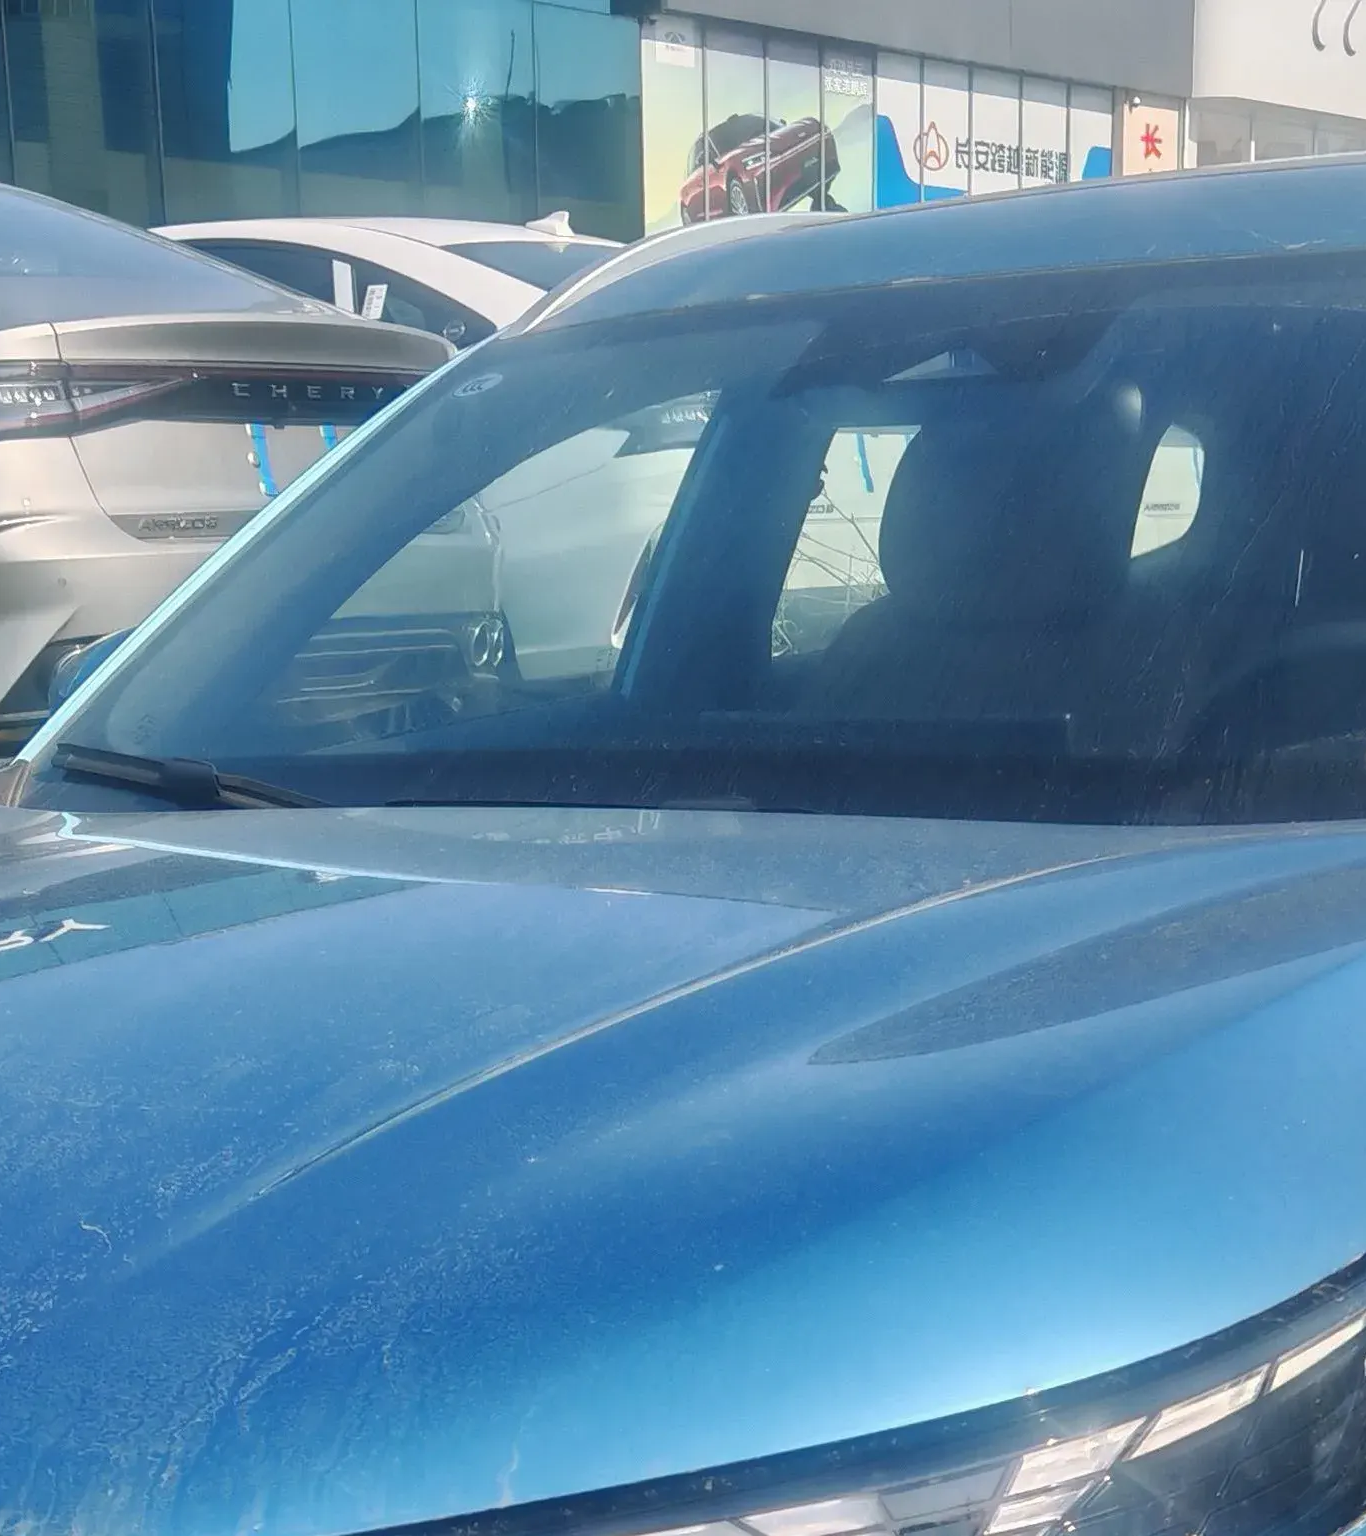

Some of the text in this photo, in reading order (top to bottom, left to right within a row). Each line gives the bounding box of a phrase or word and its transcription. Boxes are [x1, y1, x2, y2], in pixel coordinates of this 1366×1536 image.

[955, 136, 1069, 184] 长安跨越新能源
[232, 382, 383, 400] CHERY
